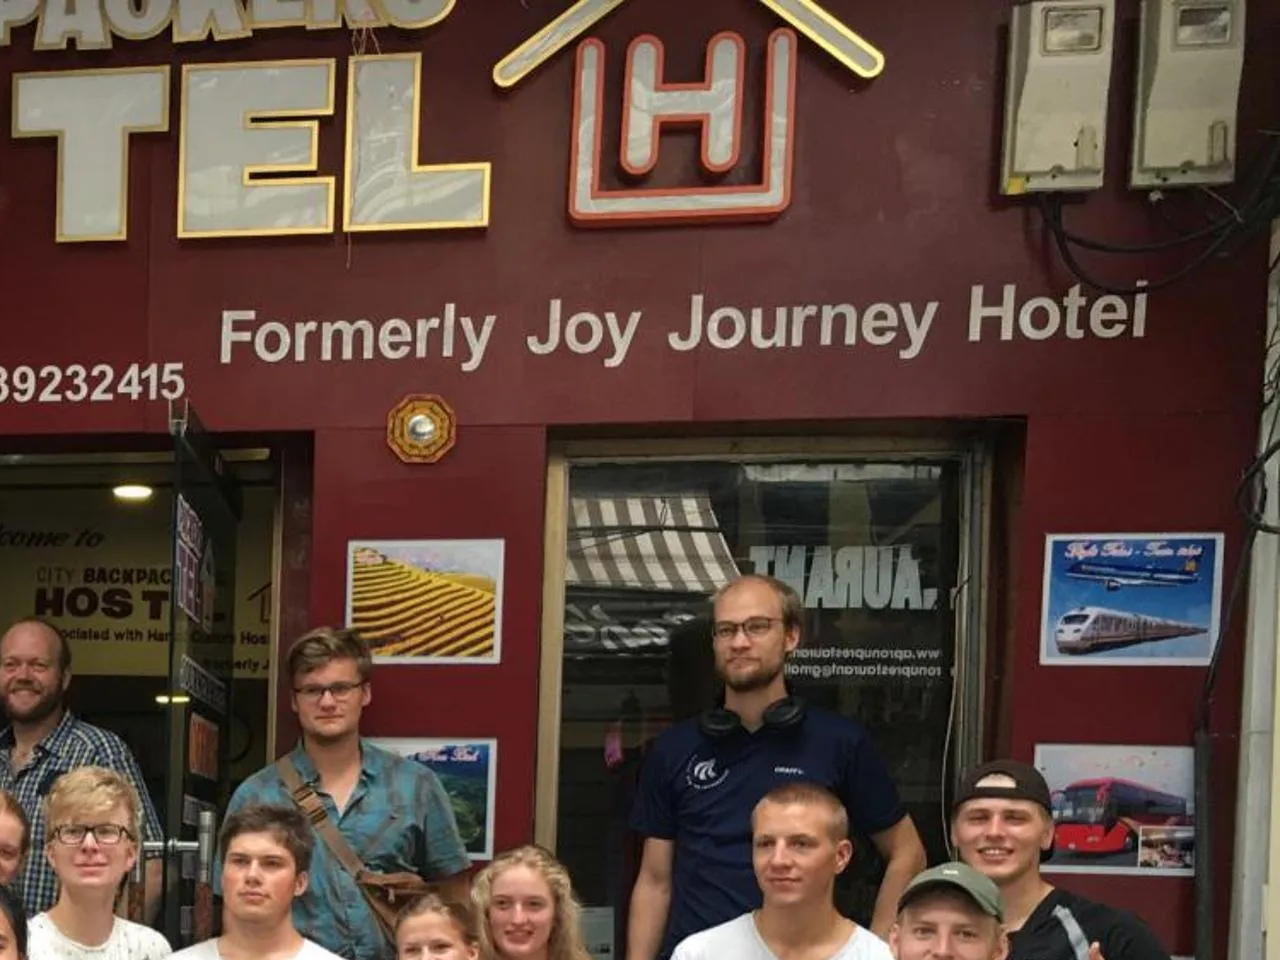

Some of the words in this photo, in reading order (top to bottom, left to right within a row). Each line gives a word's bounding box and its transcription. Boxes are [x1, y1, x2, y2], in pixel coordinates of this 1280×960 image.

[220, 303, 497, 372] Formerly
[526, 299, 642, 368] Joy
[667, 294, 939, 360] Journey
[74, 525, 104, 548] to
[36, 566, 72, 582] CITY
[114, 628, 143, 641] with
